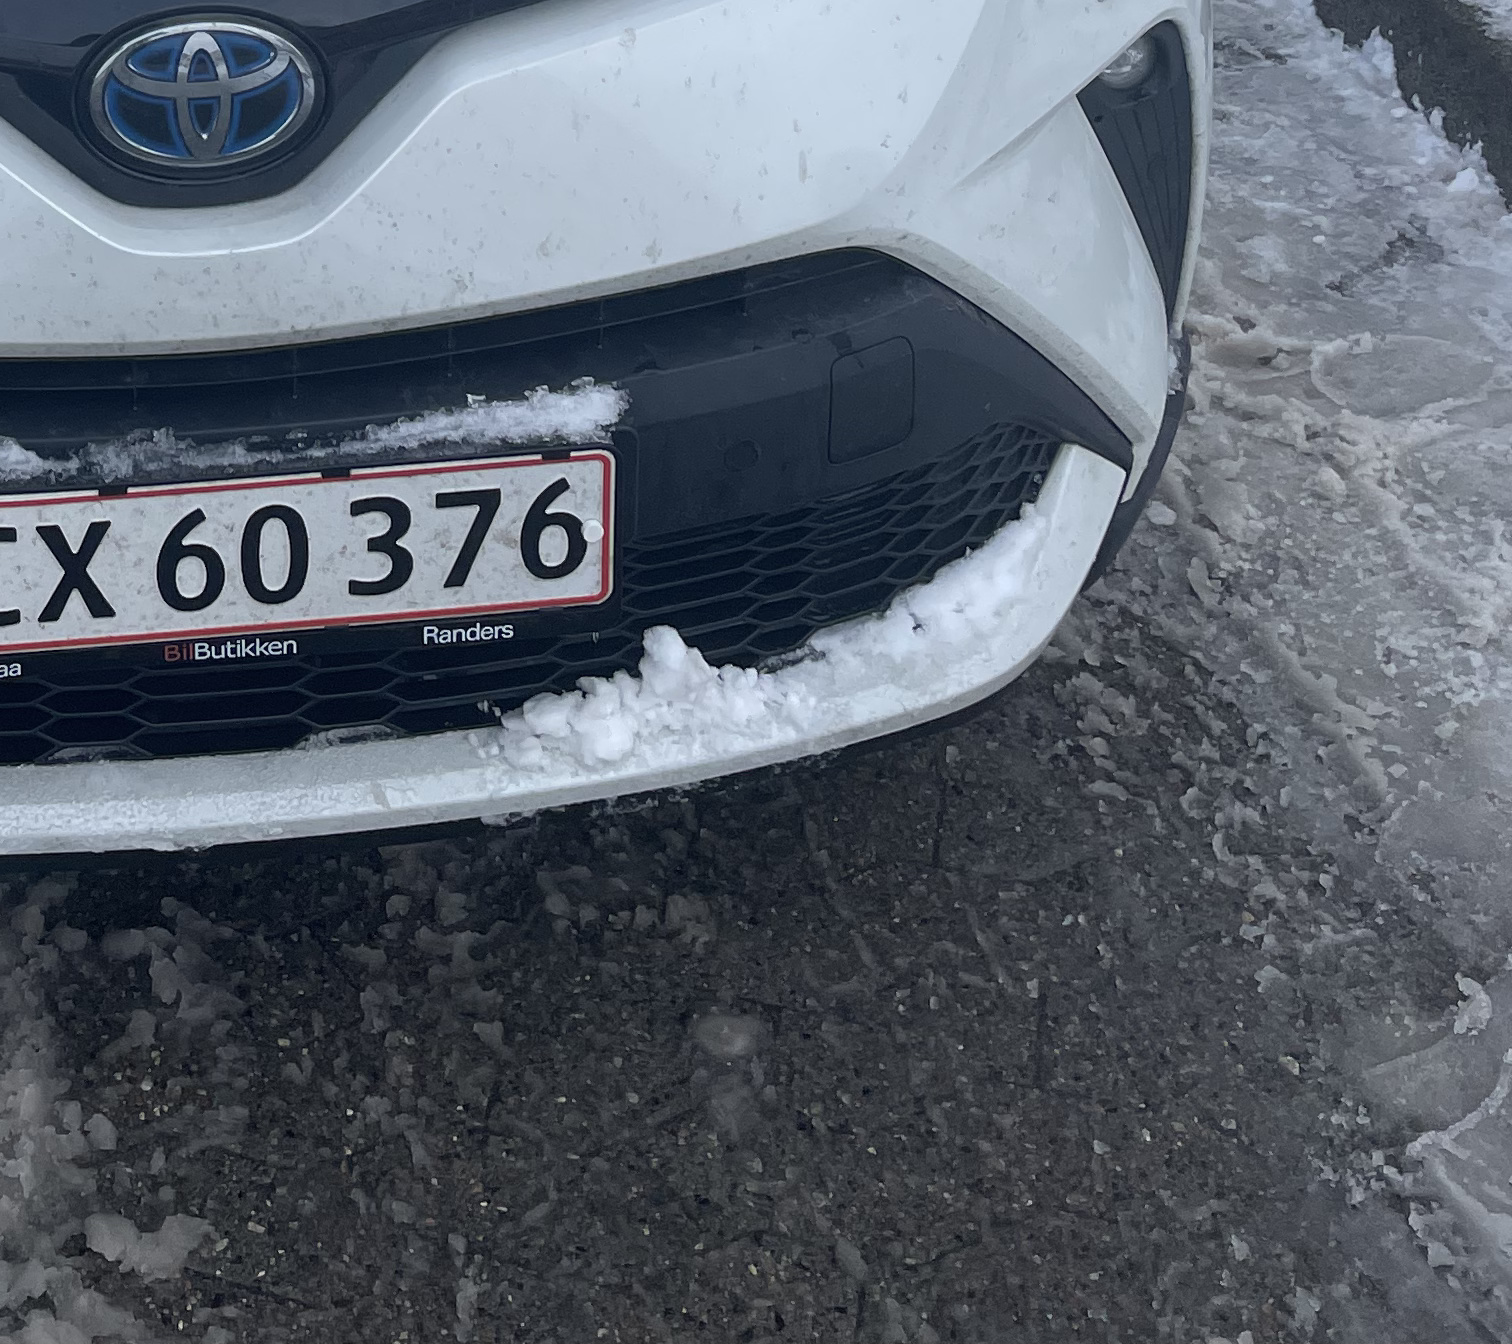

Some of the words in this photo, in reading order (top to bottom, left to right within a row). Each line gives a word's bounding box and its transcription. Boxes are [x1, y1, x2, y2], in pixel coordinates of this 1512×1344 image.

[156, 503, 310, 611] 60
[348, 477, 589, 596] 376
[423, 623, 514, 644] Randers
[163, 637, 298, 662] BilButikken
